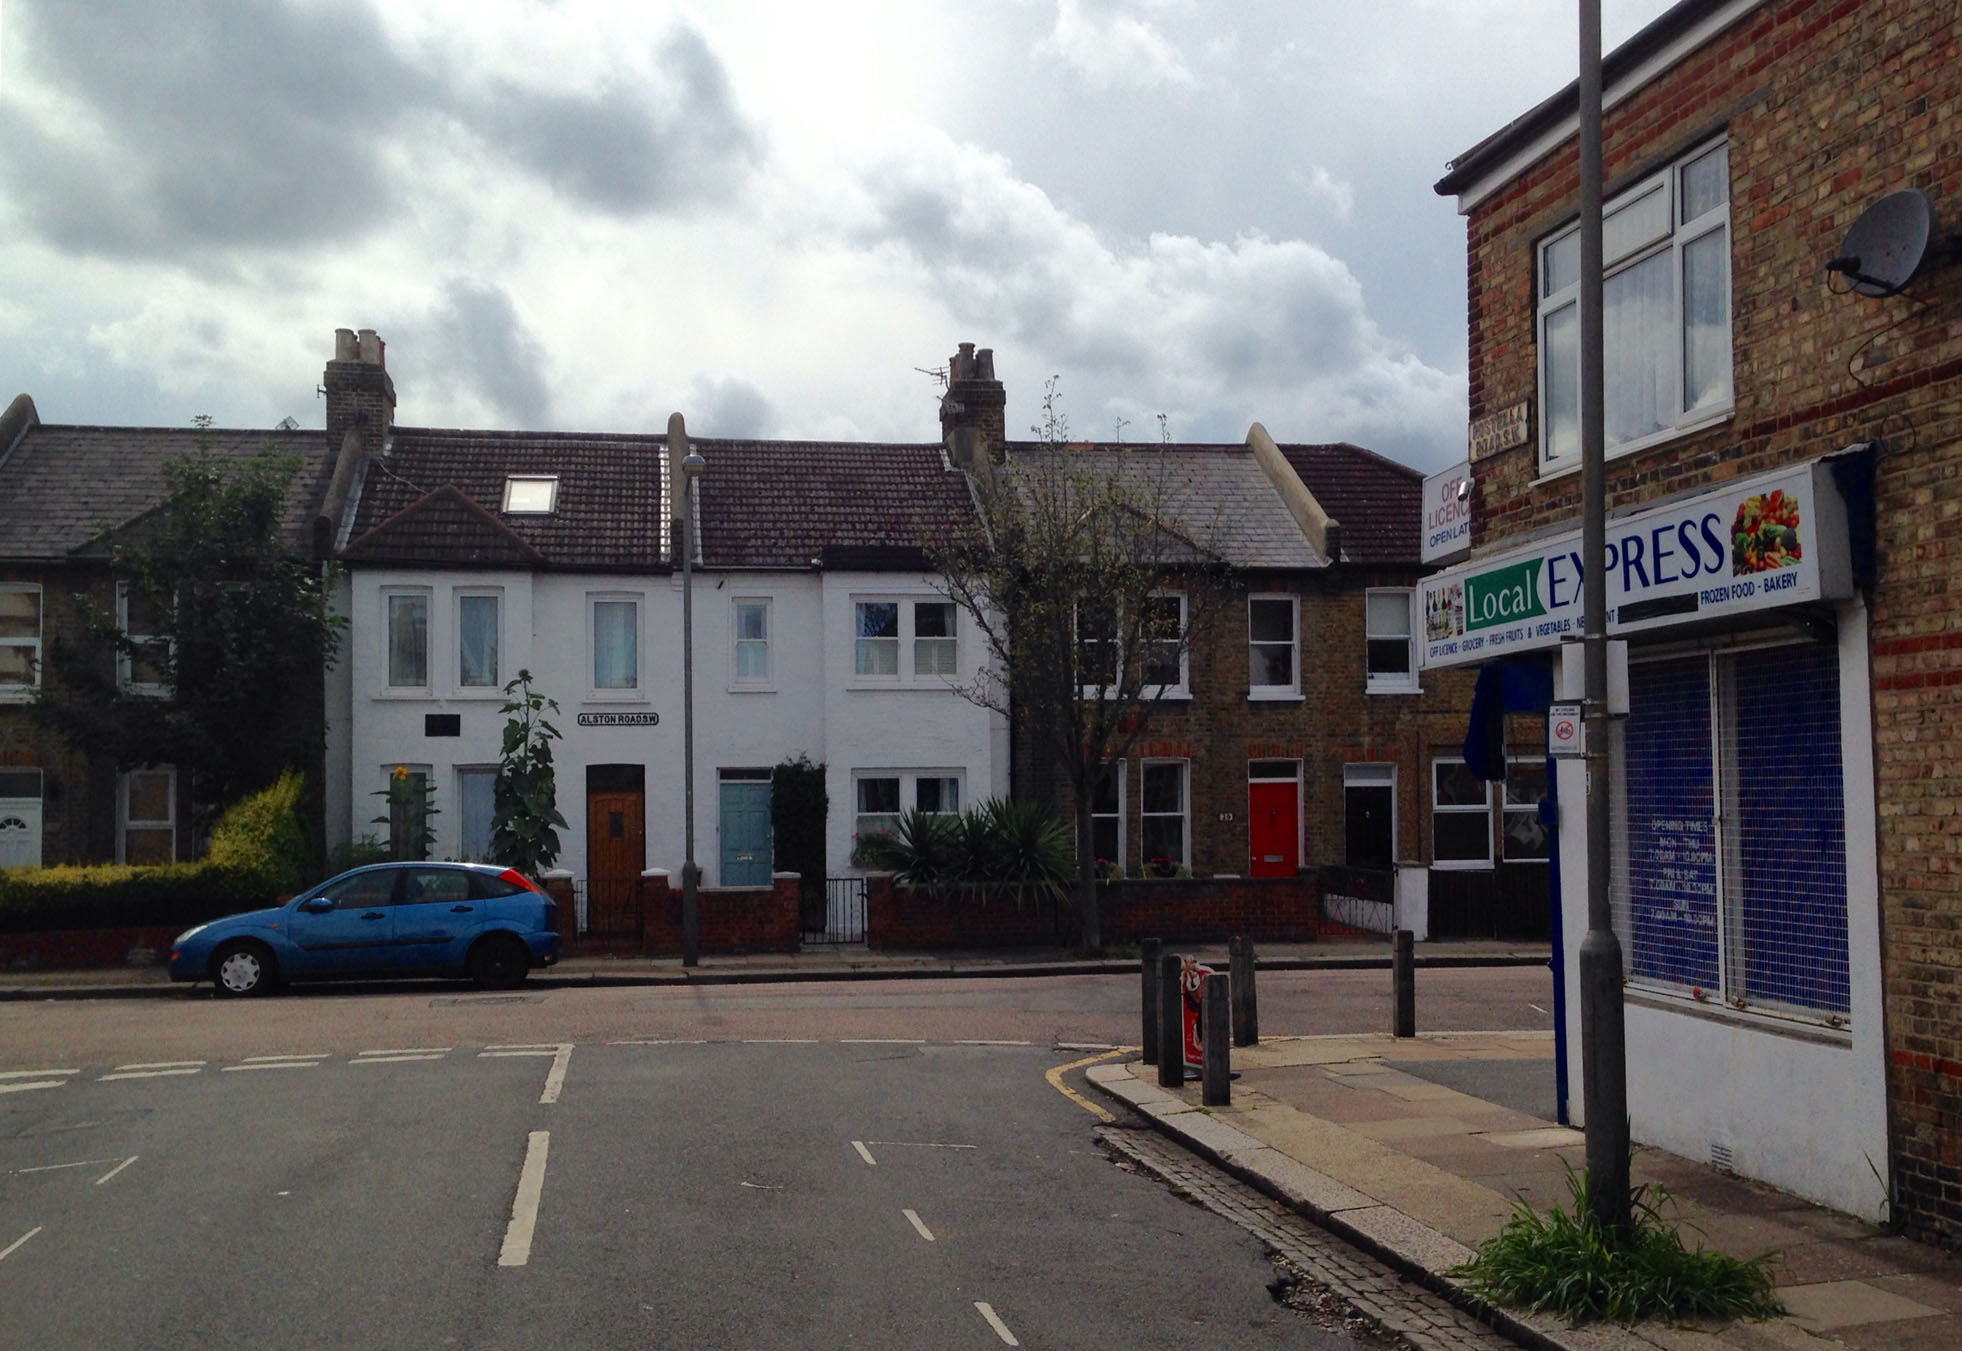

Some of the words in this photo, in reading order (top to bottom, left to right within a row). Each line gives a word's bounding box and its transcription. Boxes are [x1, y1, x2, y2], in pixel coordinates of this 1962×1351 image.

[1441, 476, 1463, 502] OFF
[1429, 500, 1471, 530] LICENC
[1429, 528, 1453, 547] OPEN
[1453, 521, 1471, 538] LAT
[1468, 569, 1533, 624] Local
[1701, 586, 1730, 605] FROZEN
[1731, 581, 1755, 599] FOOD
[1764, 571, 1798, 593] BAKERY
[1430, 646, 1438, 658] OFF
[1440, 642, 1458, 656] LICENCE
[1462, 637, 1484, 652] GROCERY
[1489, 632, 1505, 645] FRESH
[1506, 628, 1524, 642] FRUITS
[1536, 618, 1571, 637] VEGETABLES
[581, 715, 616, 723] ALSTON
[618, 715, 642, 723] ROAD
[1652, 820, 1683, 831] OPENING
[1684, 821, 1708, 832] TIMES
